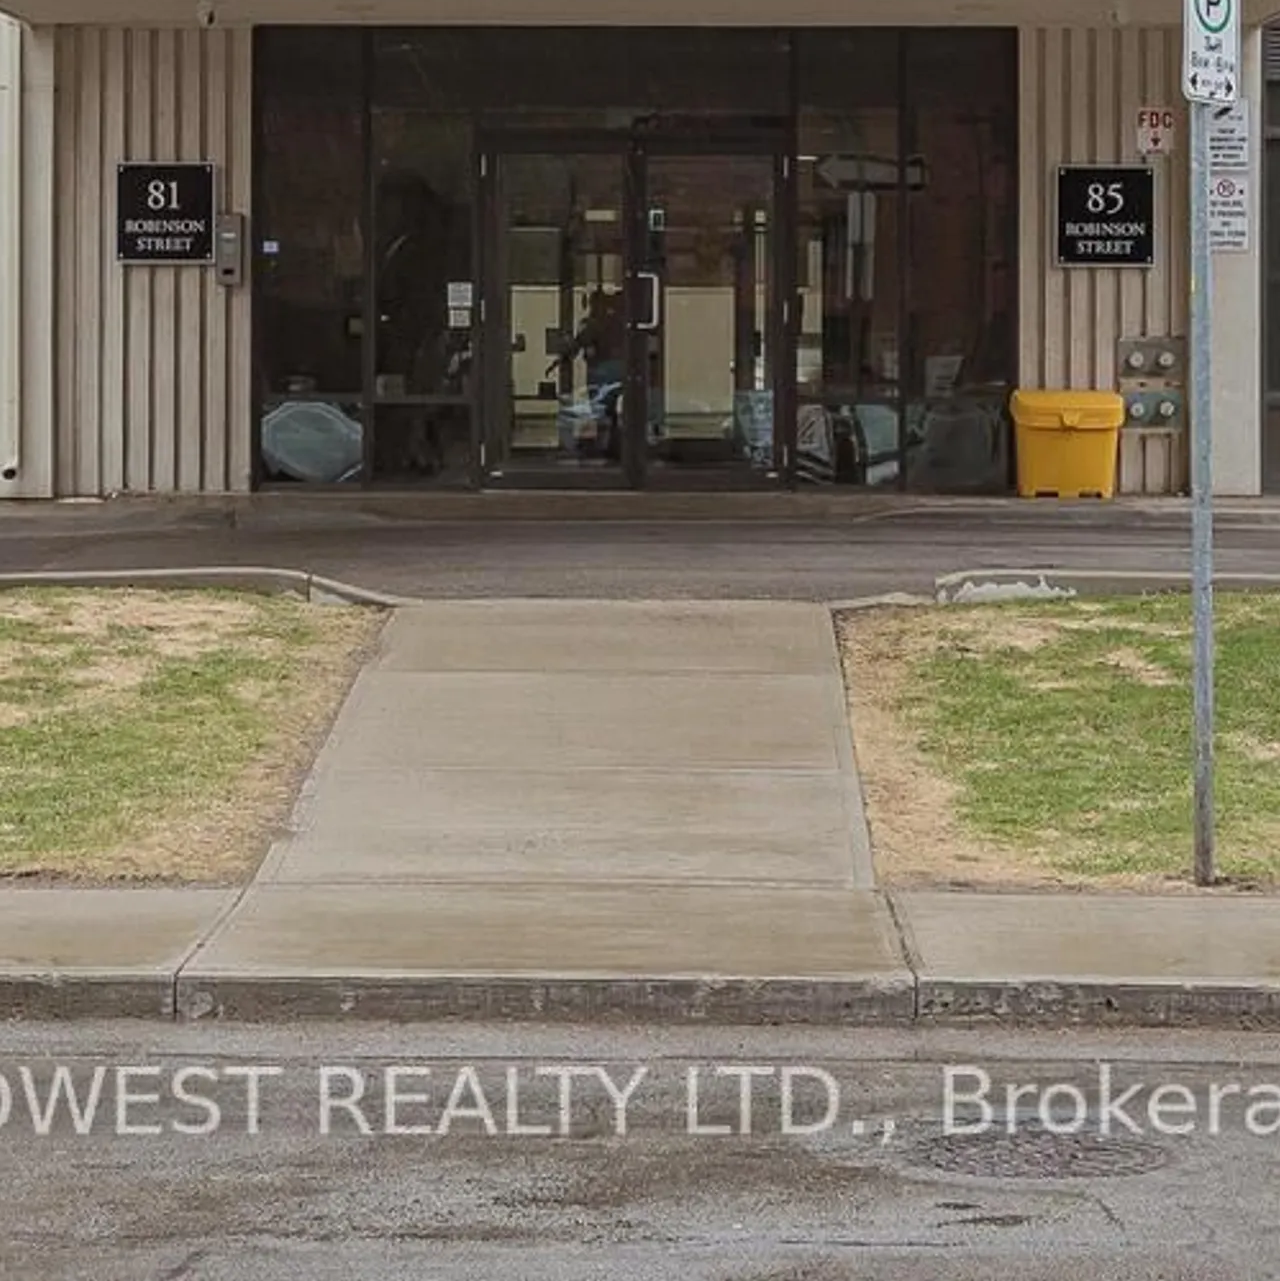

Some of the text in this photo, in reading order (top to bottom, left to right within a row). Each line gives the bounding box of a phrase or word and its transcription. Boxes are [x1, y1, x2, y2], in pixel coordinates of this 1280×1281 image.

[1138, 110, 1173, 129] FDC
[147, 179, 180, 210] 81
[1086, 183, 1125, 215] 85
[125, 220, 205, 233] ROBINSON
[1065, 222, 1145, 236] ROBINSON
[136, 237, 193, 251] STREET
[1076, 240, 1134, 255] STREET
